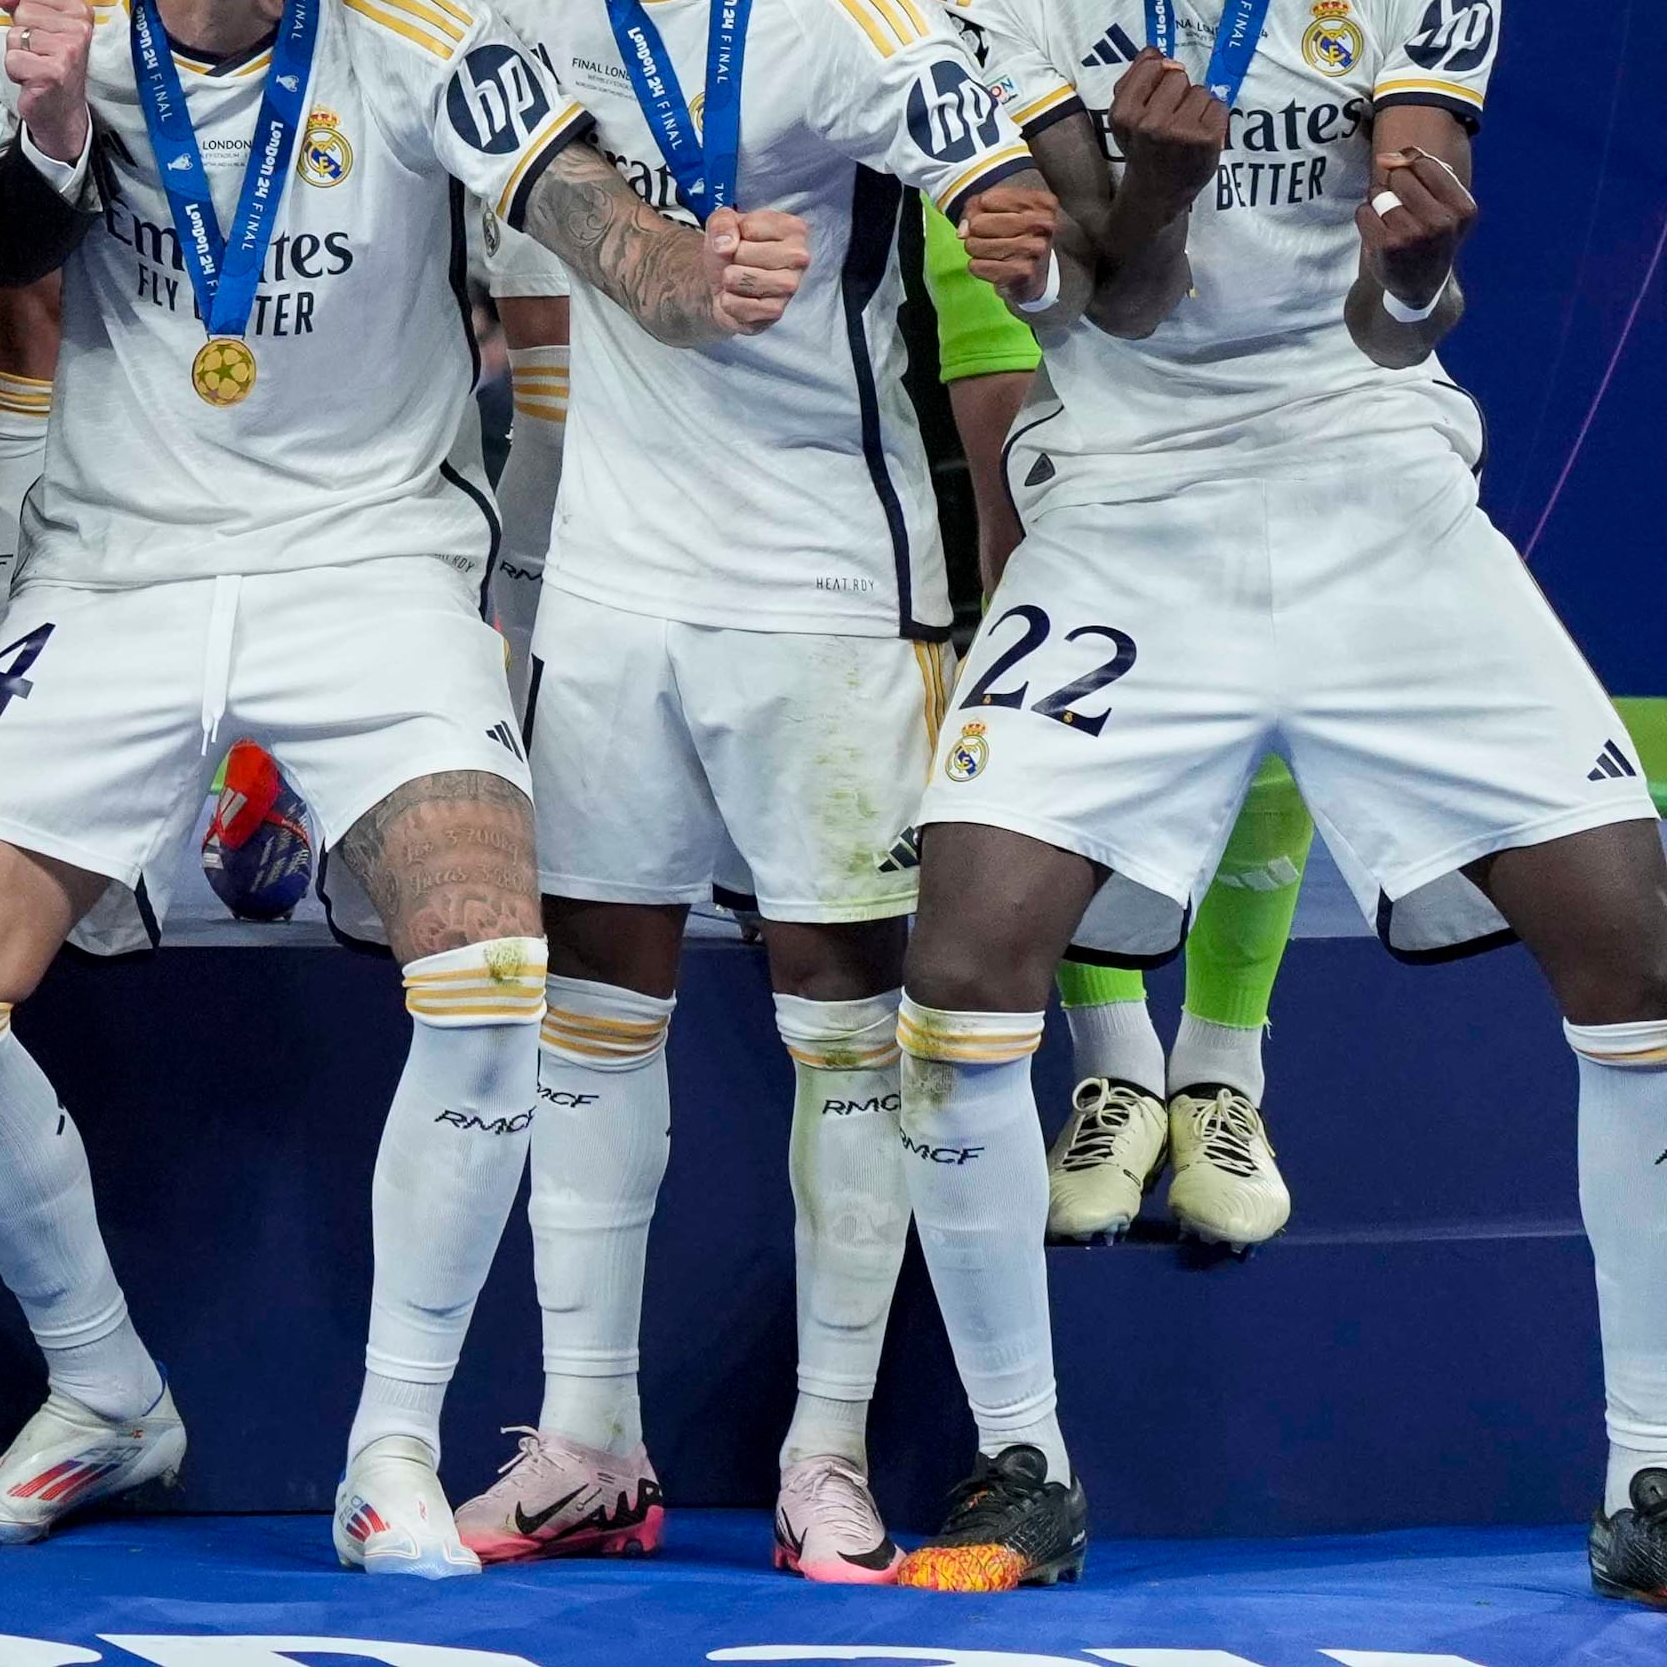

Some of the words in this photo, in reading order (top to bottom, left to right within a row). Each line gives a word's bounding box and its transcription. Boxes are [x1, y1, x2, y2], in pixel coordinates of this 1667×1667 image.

[722, 9, 735, 29] 24
[1228, 2, 1254, 48] FINAL
[572, 57, 602, 73] FINAL
[717, 36, 733, 84] FINAL
[446, 45, 549, 153] hp
[906, 61, 999, 163] hp
[1229, 99, 1371, 152] rates
[255, 177, 269, 198] 24
[1217, 157, 1326, 211] BETTER
[242, 202, 264, 250] FINAL
[137, 264, 177, 312] FLY
[816, 577, 875, 591] HEAT.RDY
[958, 605, 1138, 737] 22
[823, 1097, 900, 1116] RMC
